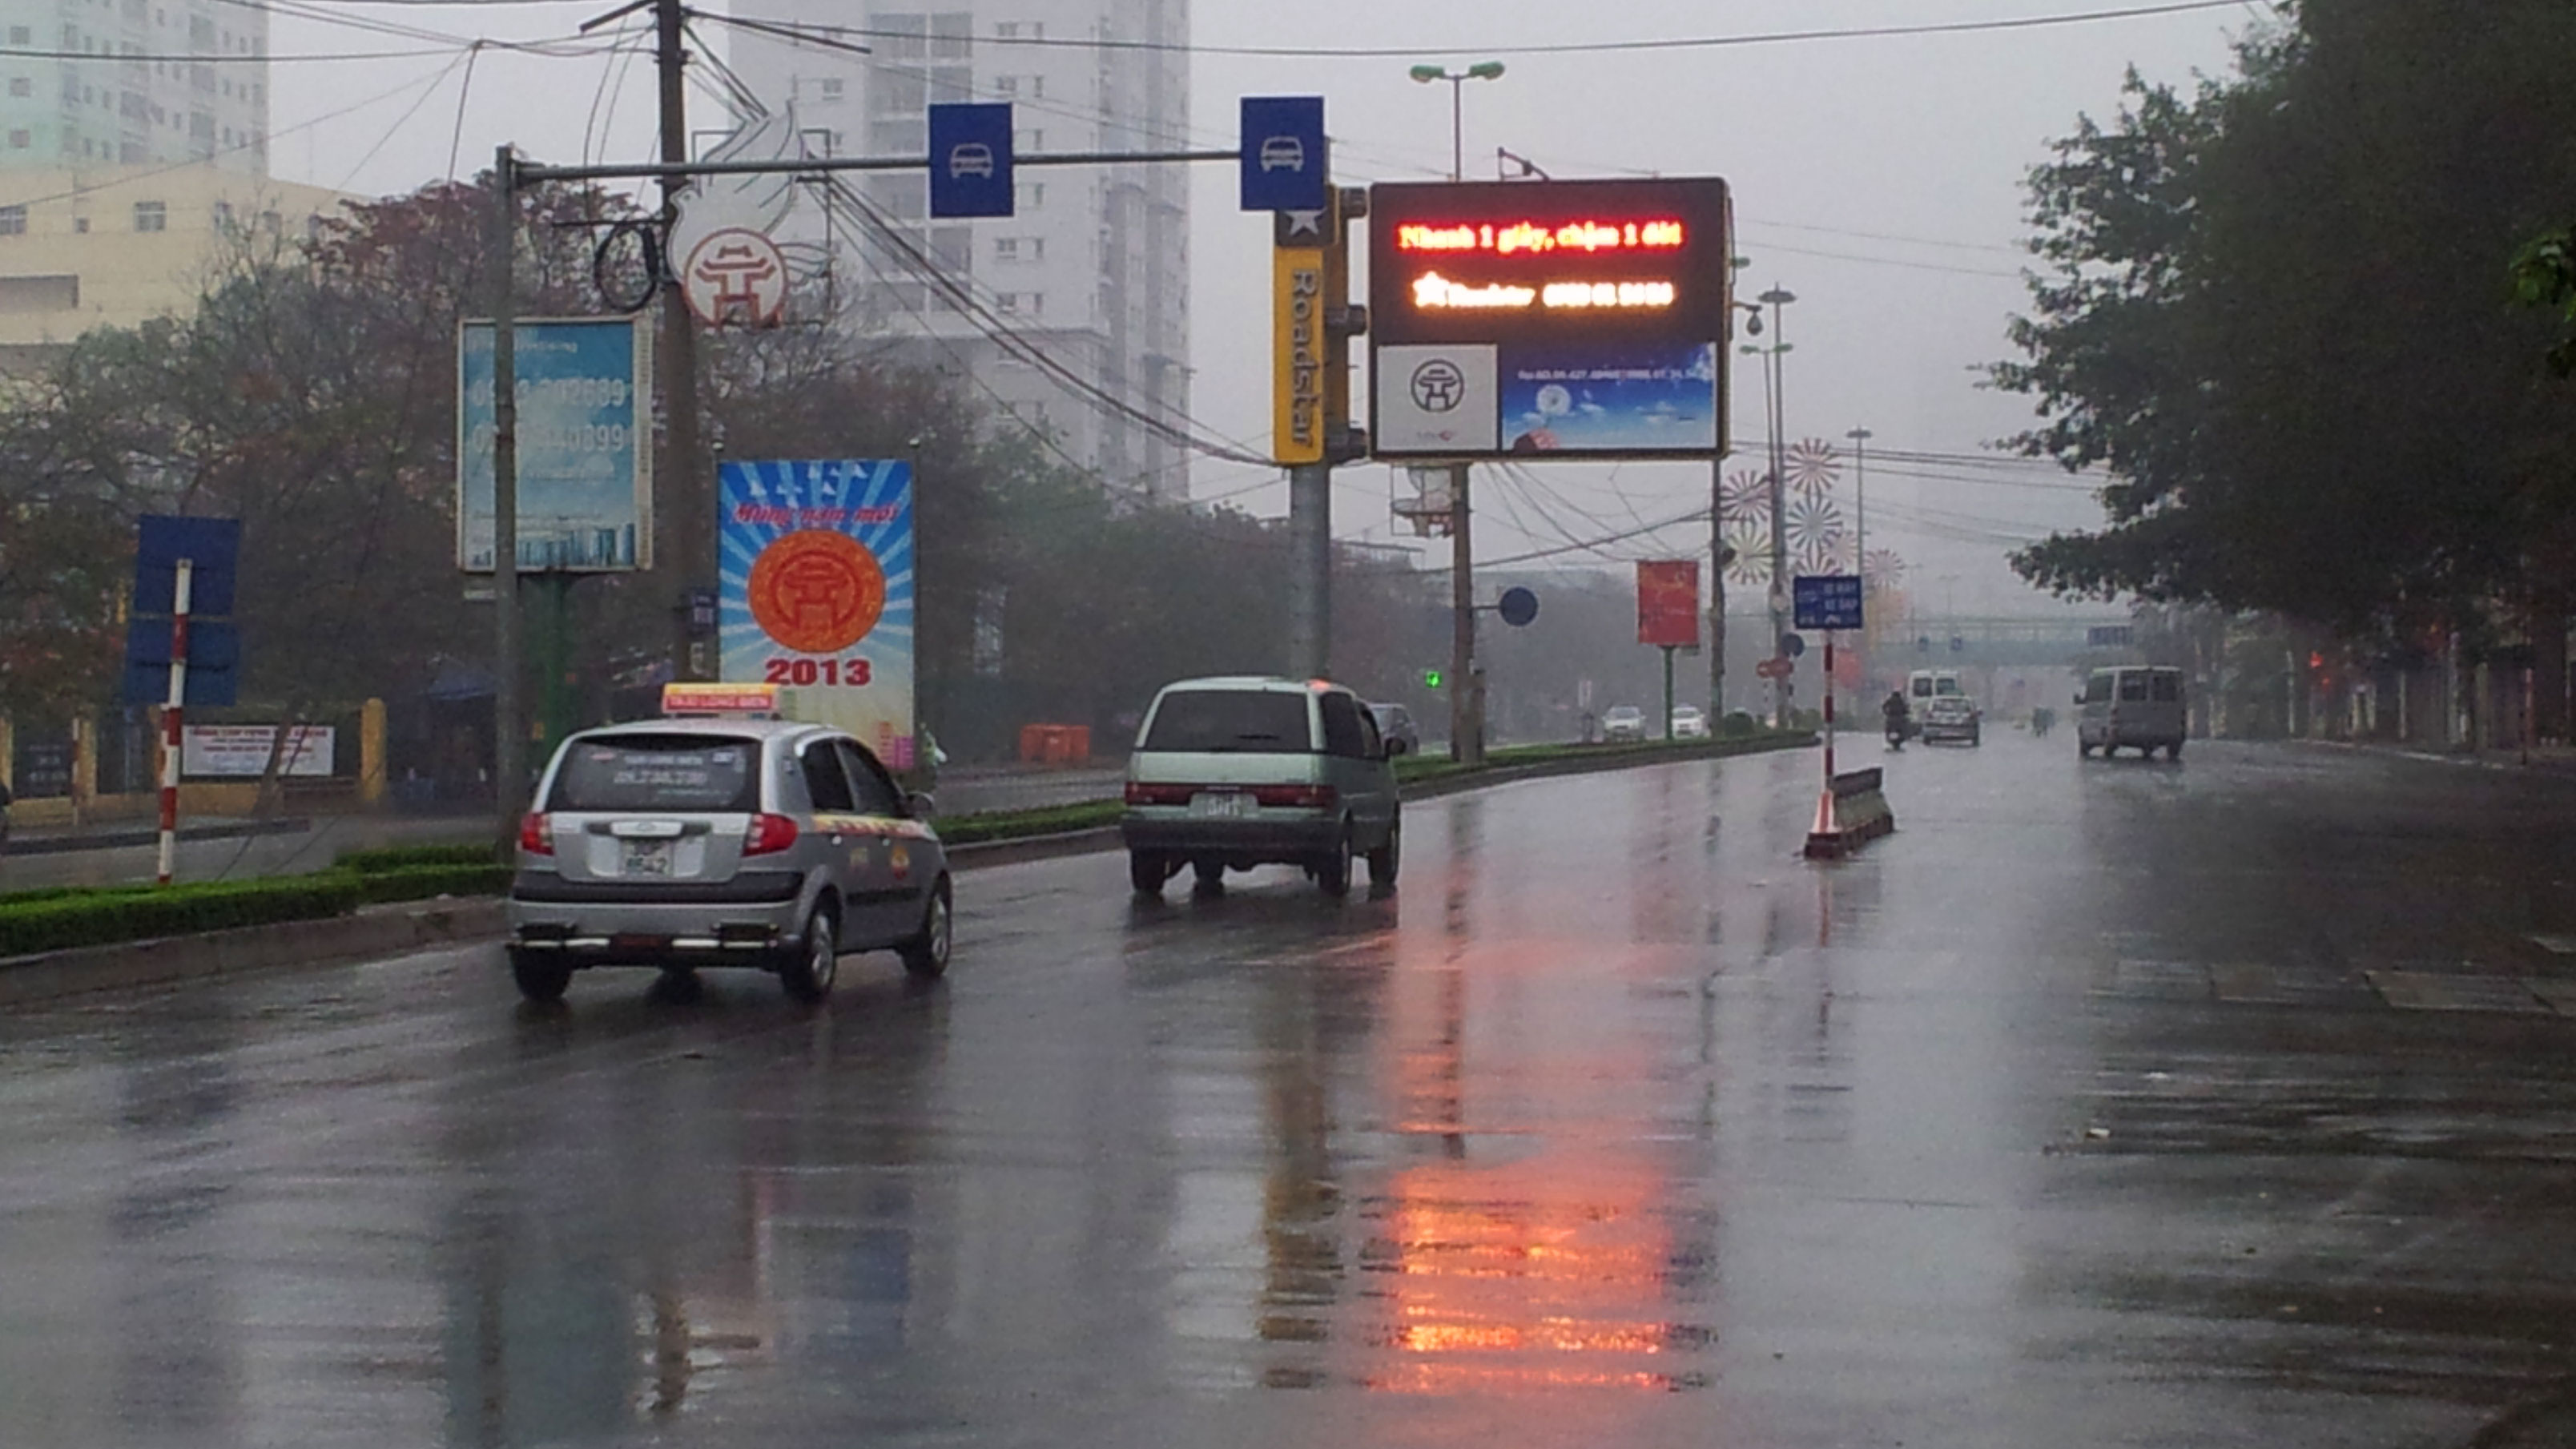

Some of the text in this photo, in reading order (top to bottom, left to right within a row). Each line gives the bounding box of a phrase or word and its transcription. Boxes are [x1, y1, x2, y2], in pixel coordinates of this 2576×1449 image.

[1479, 223, 1494, 248] 1
[1624, 223, 1638, 247] 1
[1292, 269, 1319, 446] Roadstar
[765, 658, 871, 686] 2013
